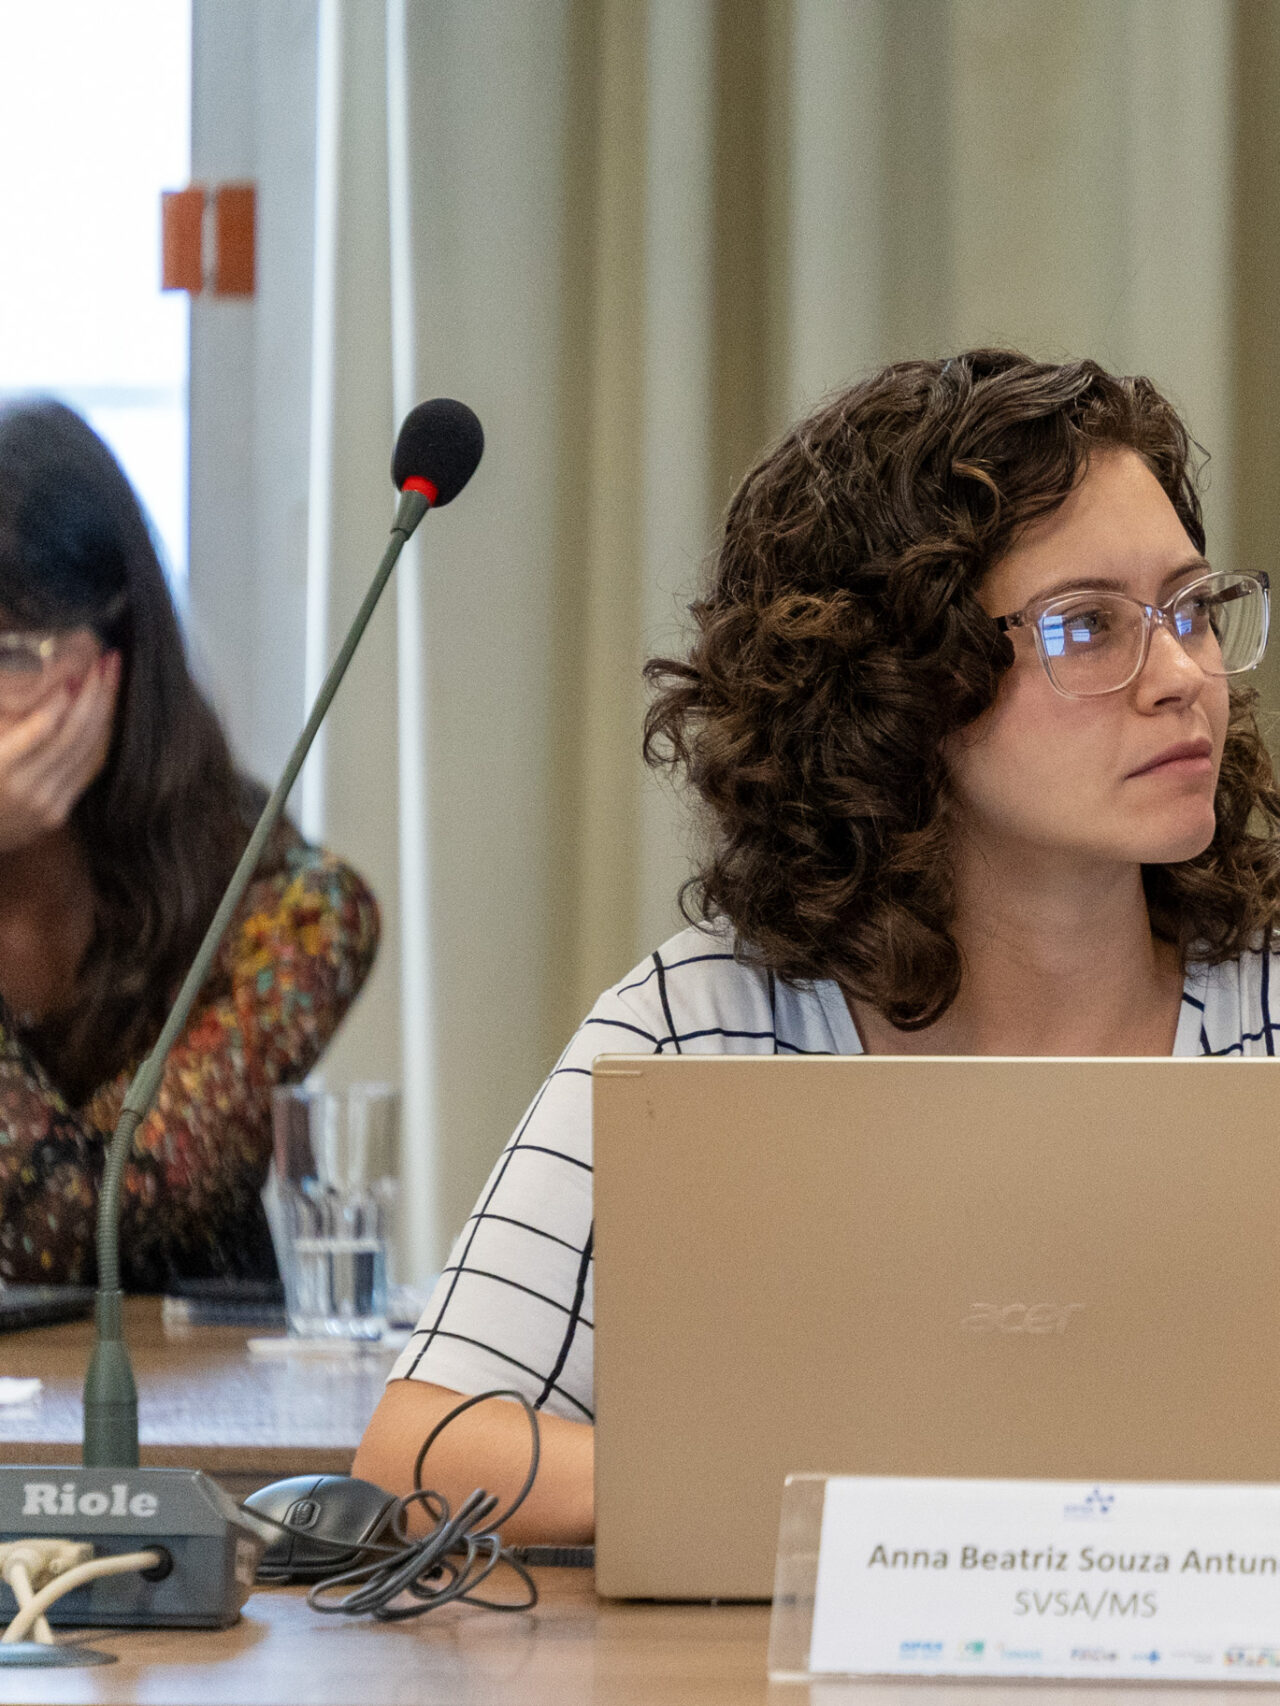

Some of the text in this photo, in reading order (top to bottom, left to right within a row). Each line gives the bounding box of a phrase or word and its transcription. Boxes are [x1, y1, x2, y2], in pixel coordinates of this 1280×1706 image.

[958, 1301, 1084, 1336] acer
[22, 1483, 158, 1518] Riole
[868, 1545, 948, 1570] Anna
[960, 1546, 1069, 1572] Beatriz
[1078, 1547, 1170, 1573] Souza
[1014, 1590, 1157, 1621] SVSA/MS
